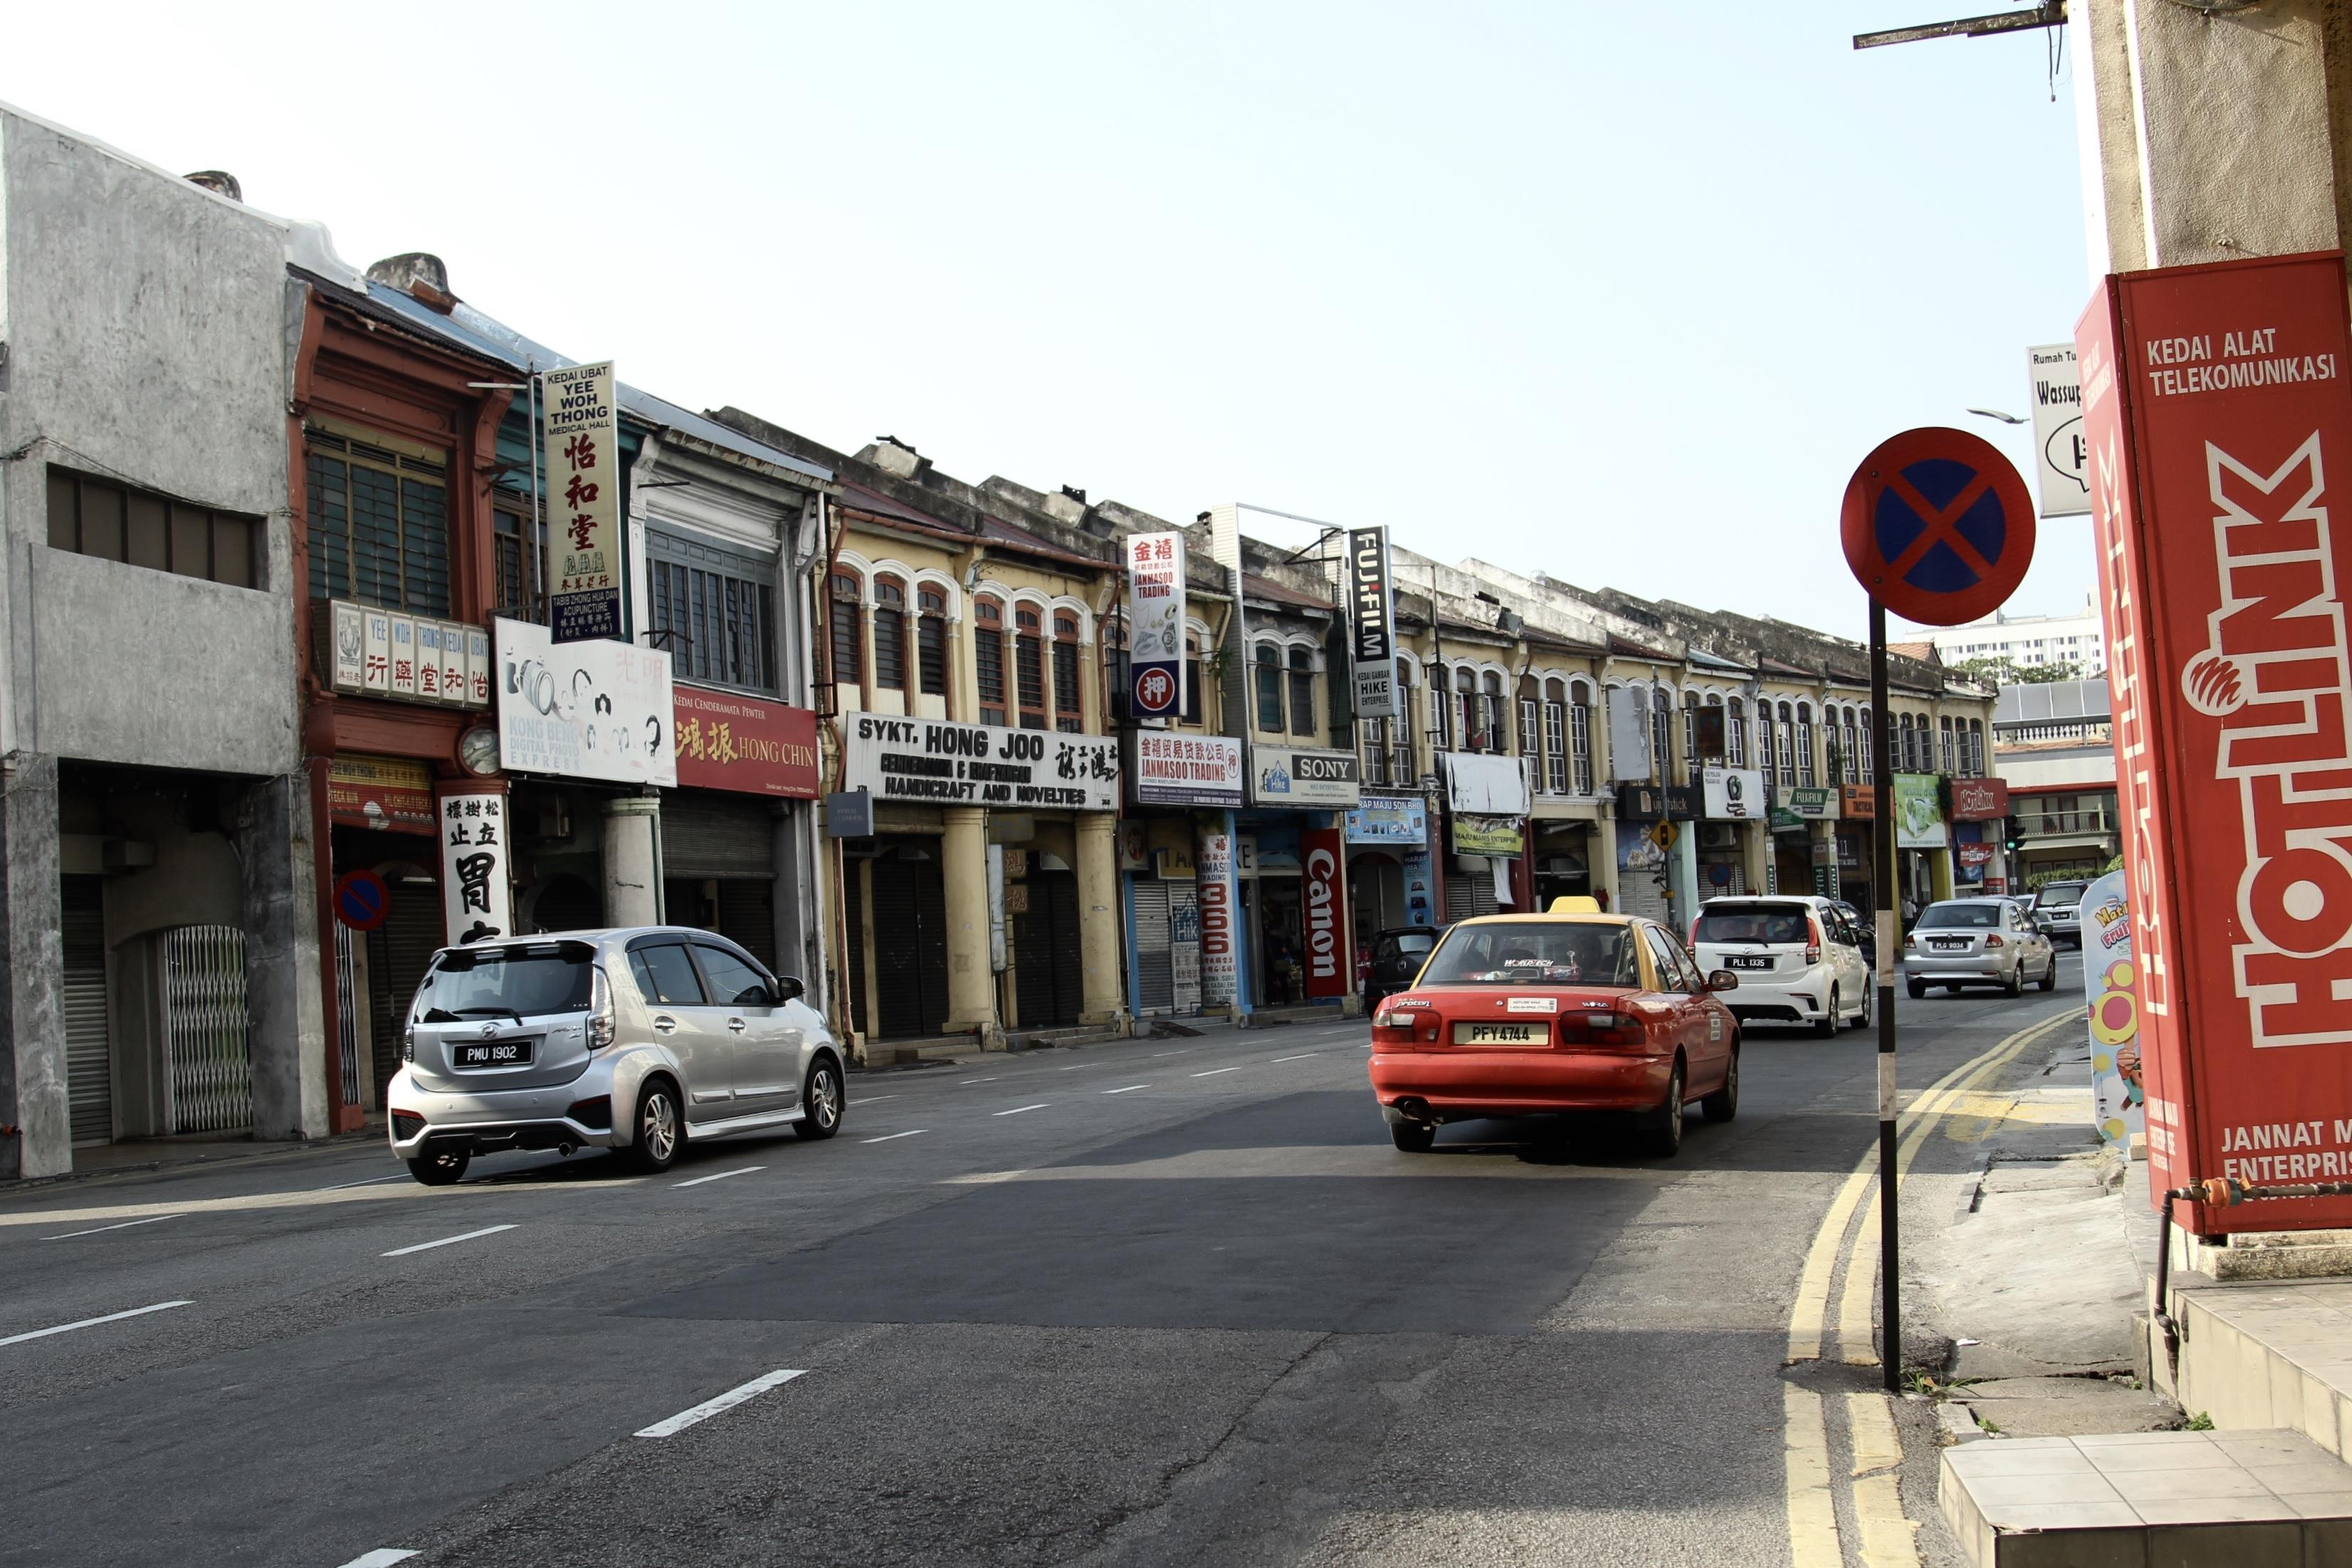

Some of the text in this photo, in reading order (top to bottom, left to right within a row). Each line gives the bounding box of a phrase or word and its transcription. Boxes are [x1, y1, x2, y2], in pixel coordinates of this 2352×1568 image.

[2146, 328, 2277, 366] KEDAI ALAT
[2033, 352, 2063, 364] Rumah
[548, 366, 608, 384] KEDAI UBAT
[2149, 354, 2336, 397] TELEKOMUNIKASI
[563, 381, 594, 396] YEE
[561, 393, 598, 410] WOH
[551, 406, 608, 425] THONG
[549, 420, 610, 435] MEDICAL HALL
[563, 433, 599, 551] 怡和堂
[1134, 539, 1173, 561] 金禧
[1134, 572, 1173, 587] JANMASOO
[553, 596, 569, 606] TABIB
[571, 593, 591, 605] ZHONG
[1138, 585, 1170, 599] TRADING
[1357, 533, 1382, 656] FUJIFILM
[563, 602, 608, 616] ACUPUNCTURE
[371, 618, 386, 641] YEE
[394, 623, 410, 645] WOH
[418, 626, 440, 649] THONG
[471, 635, 489, 658] UBAT
[1144, 676, 1167, 704] 押
[1362, 681, 1387, 694] HIKE
[674, 694, 693, 708] KEDAI
[1362, 695, 1389, 706] ENTERPRISE
[509, 716, 578, 744] KONG BENG
[859, 718, 1044, 761] SYKT. HONG JOO
[2181, 429, 2352, 1049] HOTLINK
[510, 737, 579, 758] DIGITAL PHOTO
[738, 736, 814, 768] HONG CHIN
[511, 752, 581, 770] EXPRESS
[1142, 759, 1187, 780] JANMASOO
[1190, 762, 1226, 782] TRADING
[1301, 758, 1349, 778] SONY
[885, 776, 976, 800] HANDICRAFT
[982, 784, 1012, 801] AND
[1017, 785, 1086, 805] NOVELTIES
[1271, 778, 1286, 789] Hike
[1394, 801, 1407, 810] SDN
[1796, 792, 1822, 803] FUJIFILM
[1961, 785, 1995, 812] HOTLINK
[1200, 883, 1229, 954] 366
[1308, 849, 1335, 977] Canon
[1395, 999, 1431, 1008] proton
[467, 1046, 517, 1061] PMU 1902
[2221, 1121, 2324, 1153] JANNAT
